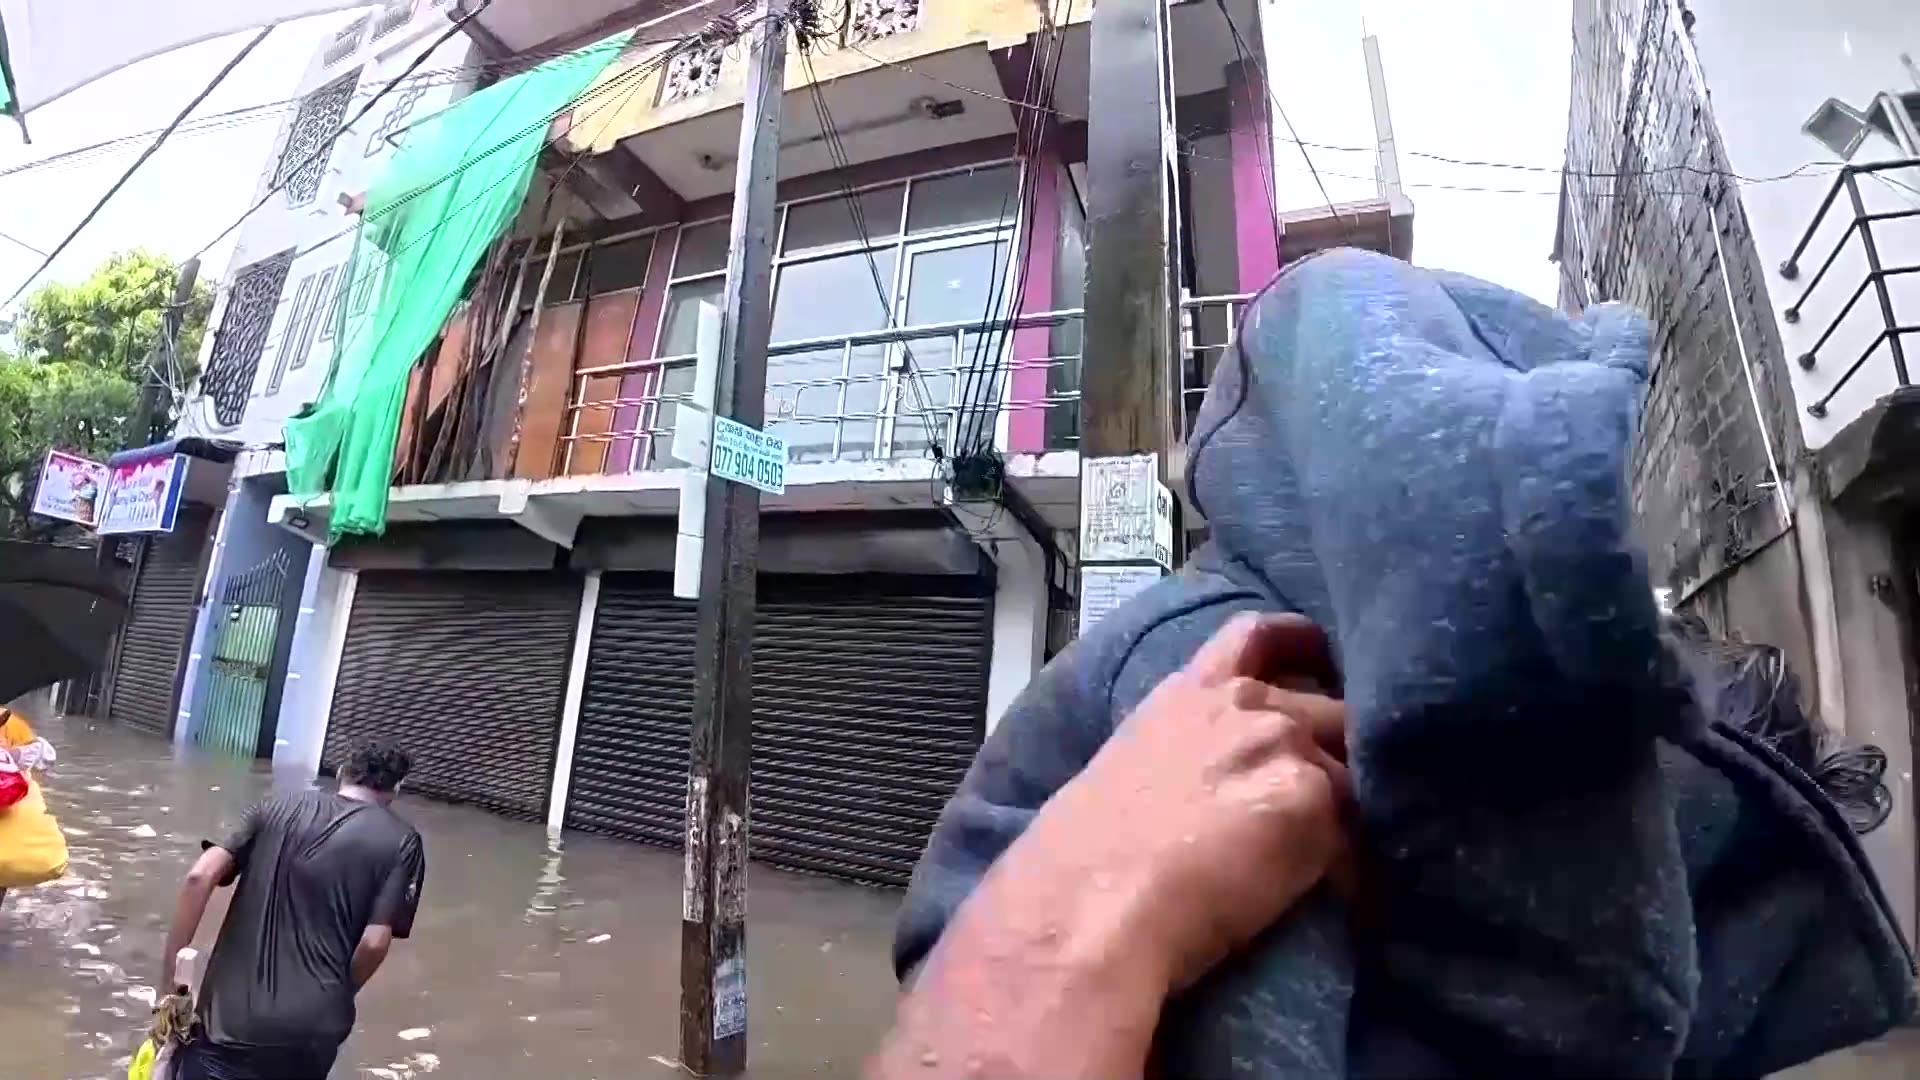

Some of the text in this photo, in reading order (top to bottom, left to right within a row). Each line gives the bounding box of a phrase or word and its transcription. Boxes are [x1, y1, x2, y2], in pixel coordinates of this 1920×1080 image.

[714, 445, 733, 472] 077
[735, 452, 754, 479] 904
[758, 459, 783, 487] 0503
